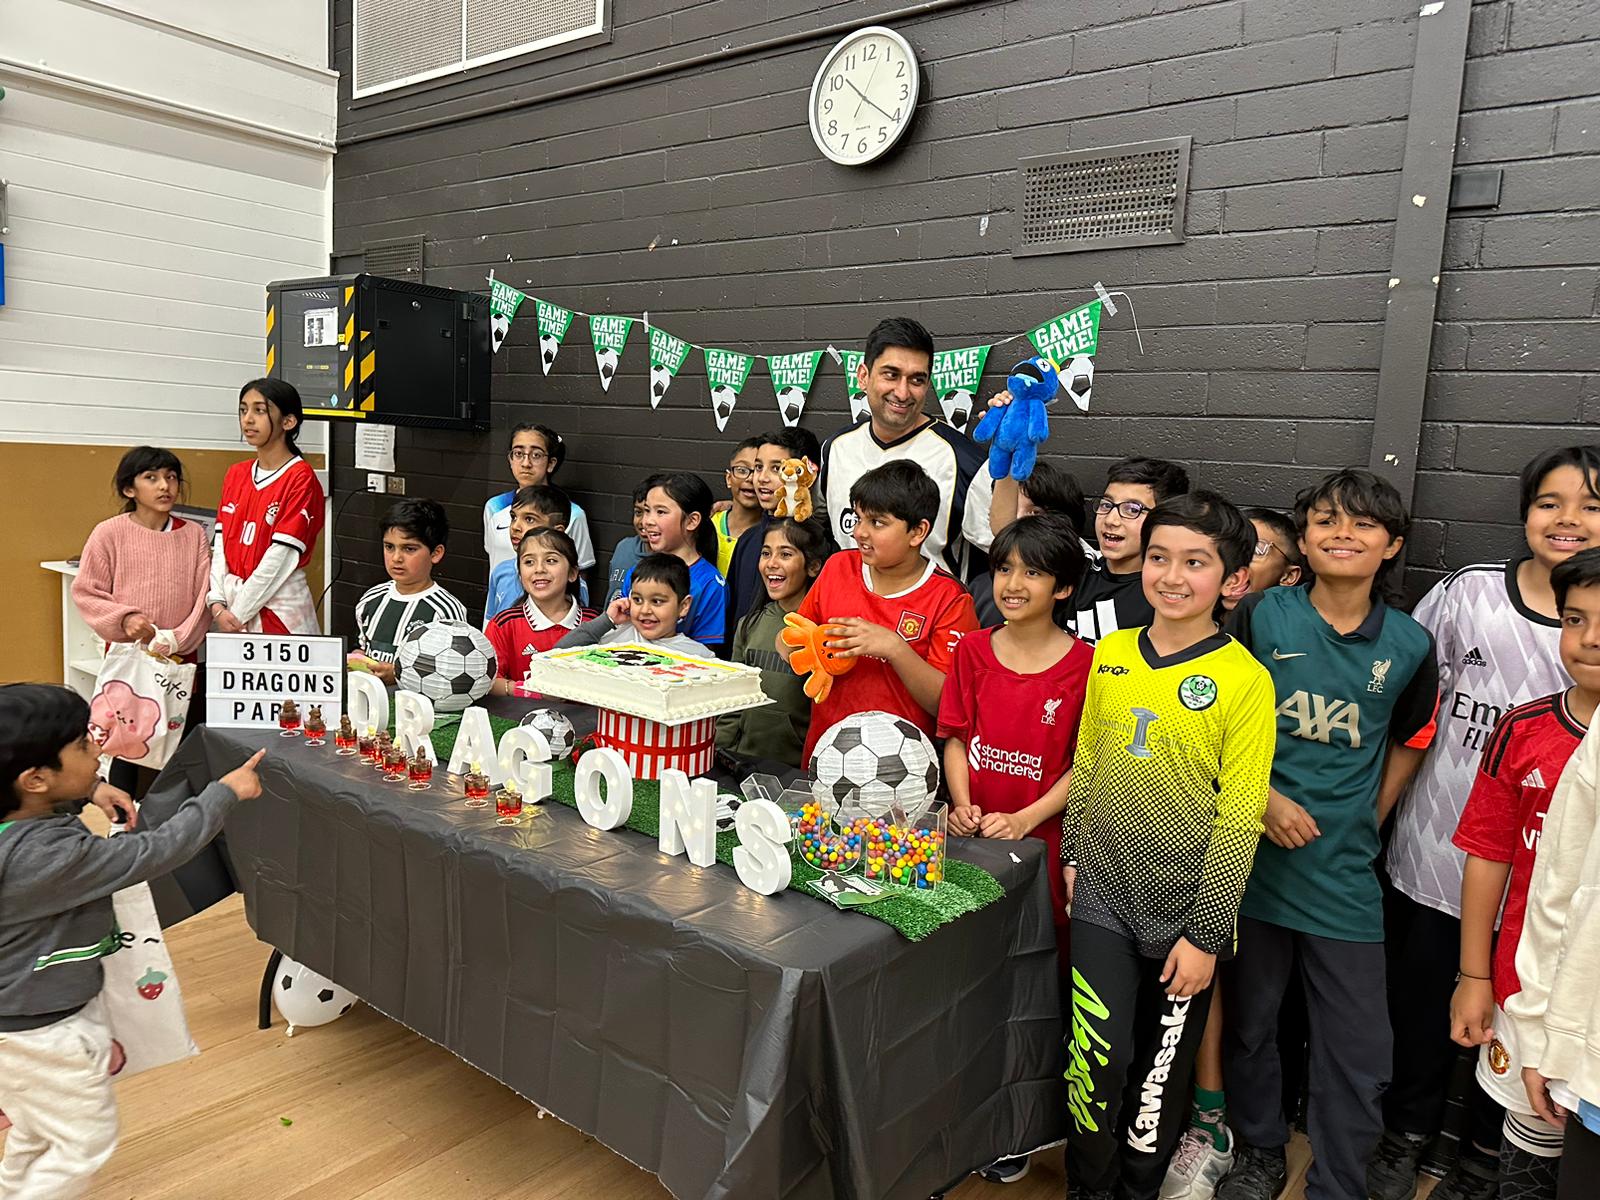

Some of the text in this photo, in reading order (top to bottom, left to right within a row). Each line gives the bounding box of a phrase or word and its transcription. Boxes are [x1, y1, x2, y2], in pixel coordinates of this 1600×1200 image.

[862, 43, 877, 62] 12
[886, 46, 891, 62] 1
[845, 54, 856, 71] 11
[895, 61, 905, 78] 2
[830, 74, 844, 92] 10
[899, 84, 909, 101] 3
[823, 98, 833, 115] 9
[892, 108, 901, 124] 4
[827, 119, 838, 136] 8
[877, 126, 887, 143] 5
[840, 134, 849, 150] 7
[857, 137, 867, 153] 6
[492, 283, 519, 305] GAME
[490, 297, 514, 316] TIME!
[538, 304, 568, 324] GAME
[538, 320, 565, 337] TIME!
[592, 317, 626, 334] GAME
[1035, 308, 1093, 347] GAME
[593, 332, 623, 347] TIME!
[652, 331, 685, 356] GAME
[1042, 332, 1094, 363] TIME!
[651, 347, 680, 368] TIME!
[708, 351, 746, 371] GAME
[771, 352, 814, 369] GAME
[846, 354, 865, 372] GA
[932, 349, 979, 373] GAME
[709, 367, 743, 386] TIME!
[773, 369, 810, 385] TIME!
[934, 368, 977, 391] TIME!
[239, 520, 256, 546] 10
[243, 641, 310, 663] 3150
[154, 673, 187, 700] cute
[223, 670, 334, 694] DRAGONS
[1366, 683, 1384, 693] LFC
[233, 701, 322, 721] PAR
[981, 743, 1042, 769] standard
[981, 757, 1043, 782] chartered
